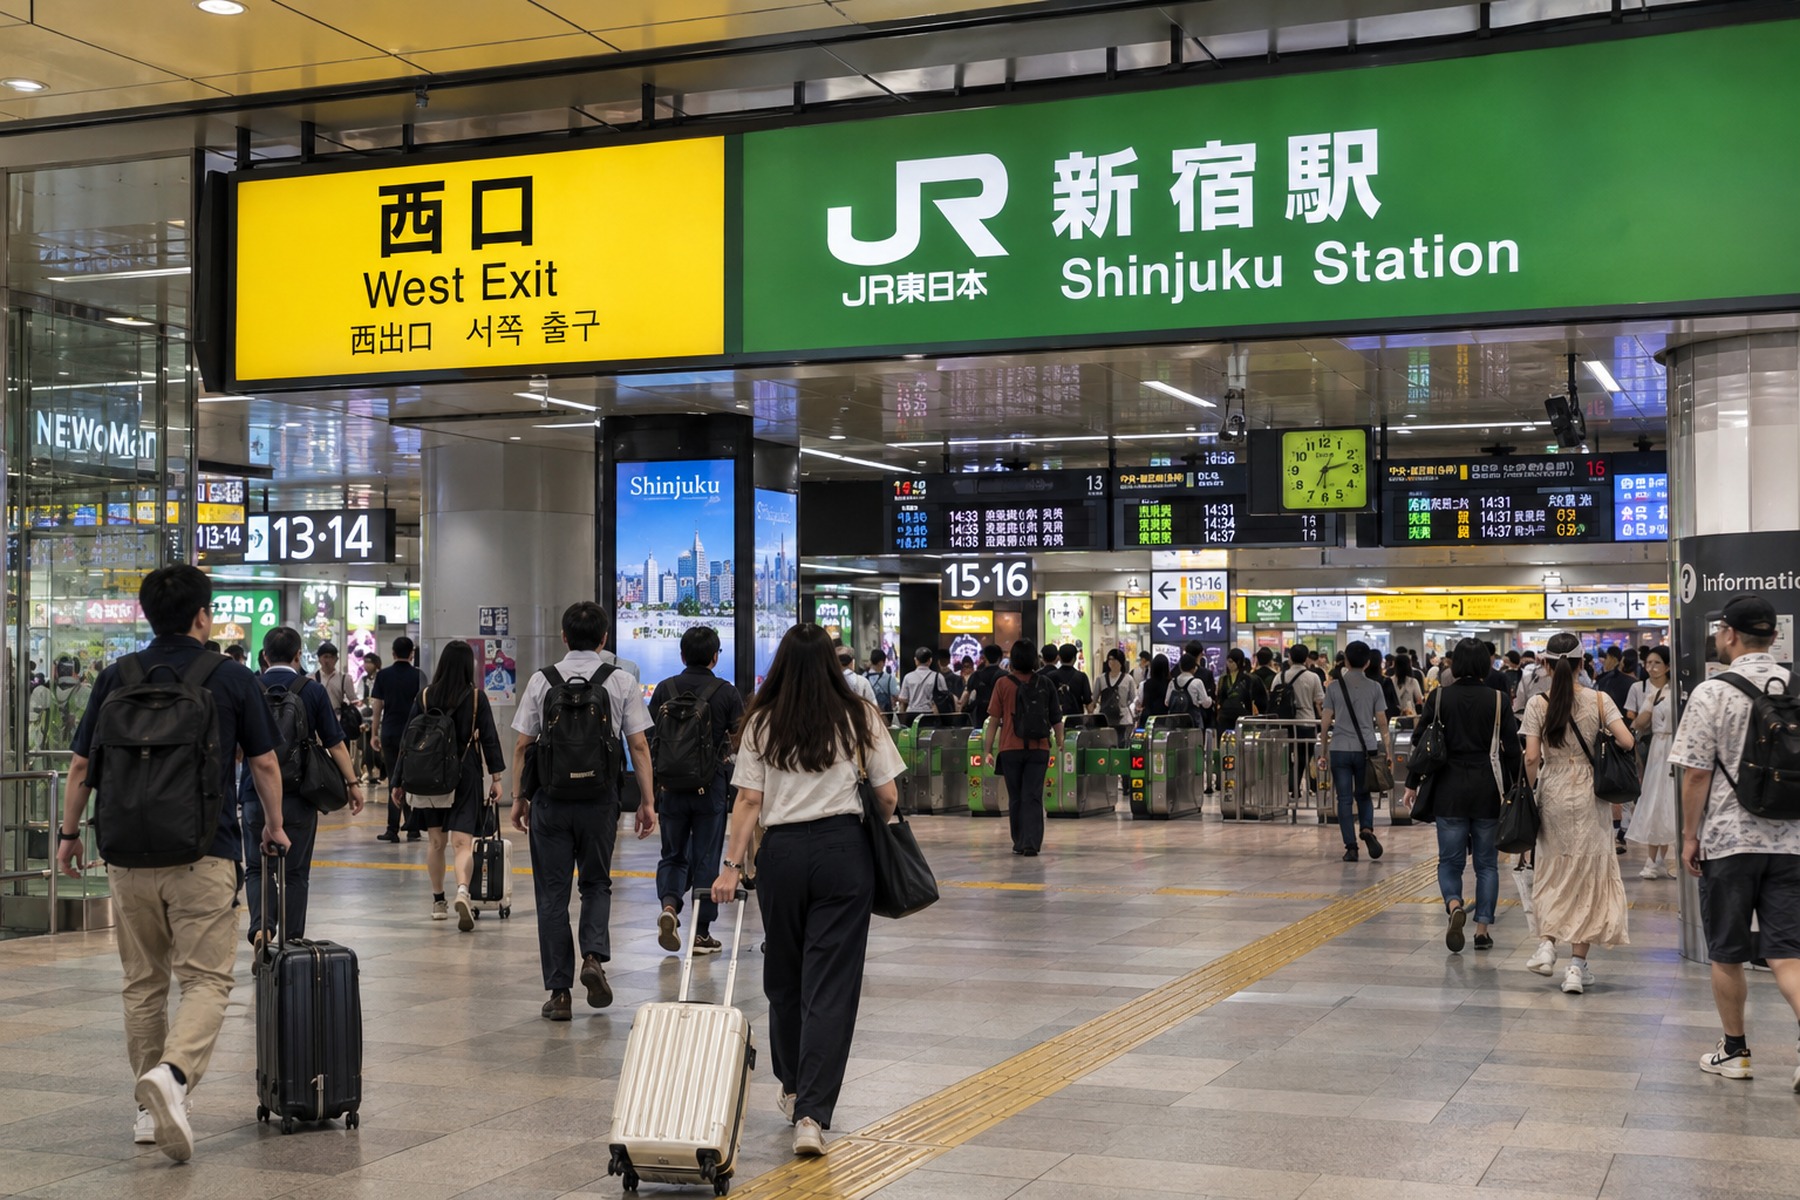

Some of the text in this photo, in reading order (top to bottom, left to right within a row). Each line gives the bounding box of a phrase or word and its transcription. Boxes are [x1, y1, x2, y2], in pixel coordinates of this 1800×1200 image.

[1052, 128, 1381, 241] 新宿駅
[827, 153, 1009, 266] JR
[378, 176, 533, 258] 西口
[1061, 234, 1519, 305] Shinjuku Station
[363, 259, 558, 309] West Exit
[842, 268, 988, 307] JR東日本
[466, 309, 601, 348] 서쪽 출구
[350, 321, 432, 356] 西出口
[1306, 441, 1315, 452] 11
[1318, 437, 1331, 449] 12
[1336, 440, 1342, 450] 1
[1295, 451, 1308, 462] 10
[1346, 449, 1355, 460] 2
[1291, 465, 1300, 476] 9
[1351, 463, 1360, 474] 3
[1586, 460, 1606, 477] 16
[630, 474, 720, 500] Shinjuku
[1086, 475, 1104, 492] 13
[1295, 479, 1304, 490] 8
[1346, 479, 1355, 489] 4
[1307, 490, 1316, 500] 7
[1321, 492, 1330, 503] 6
[1335, 489, 1344, 500] 5
[1480, 496, 1511, 509] 14:31
[1203, 503, 1234, 517] 14:31
[1204, 517, 1235, 530] 14:34
[272, 514, 373, 559] 13·14
[1204, 530, 1235, 543] 14:37
[1481, 524, 1512, 538] 14:37
[945, 562, 1029, 597] 15·16
